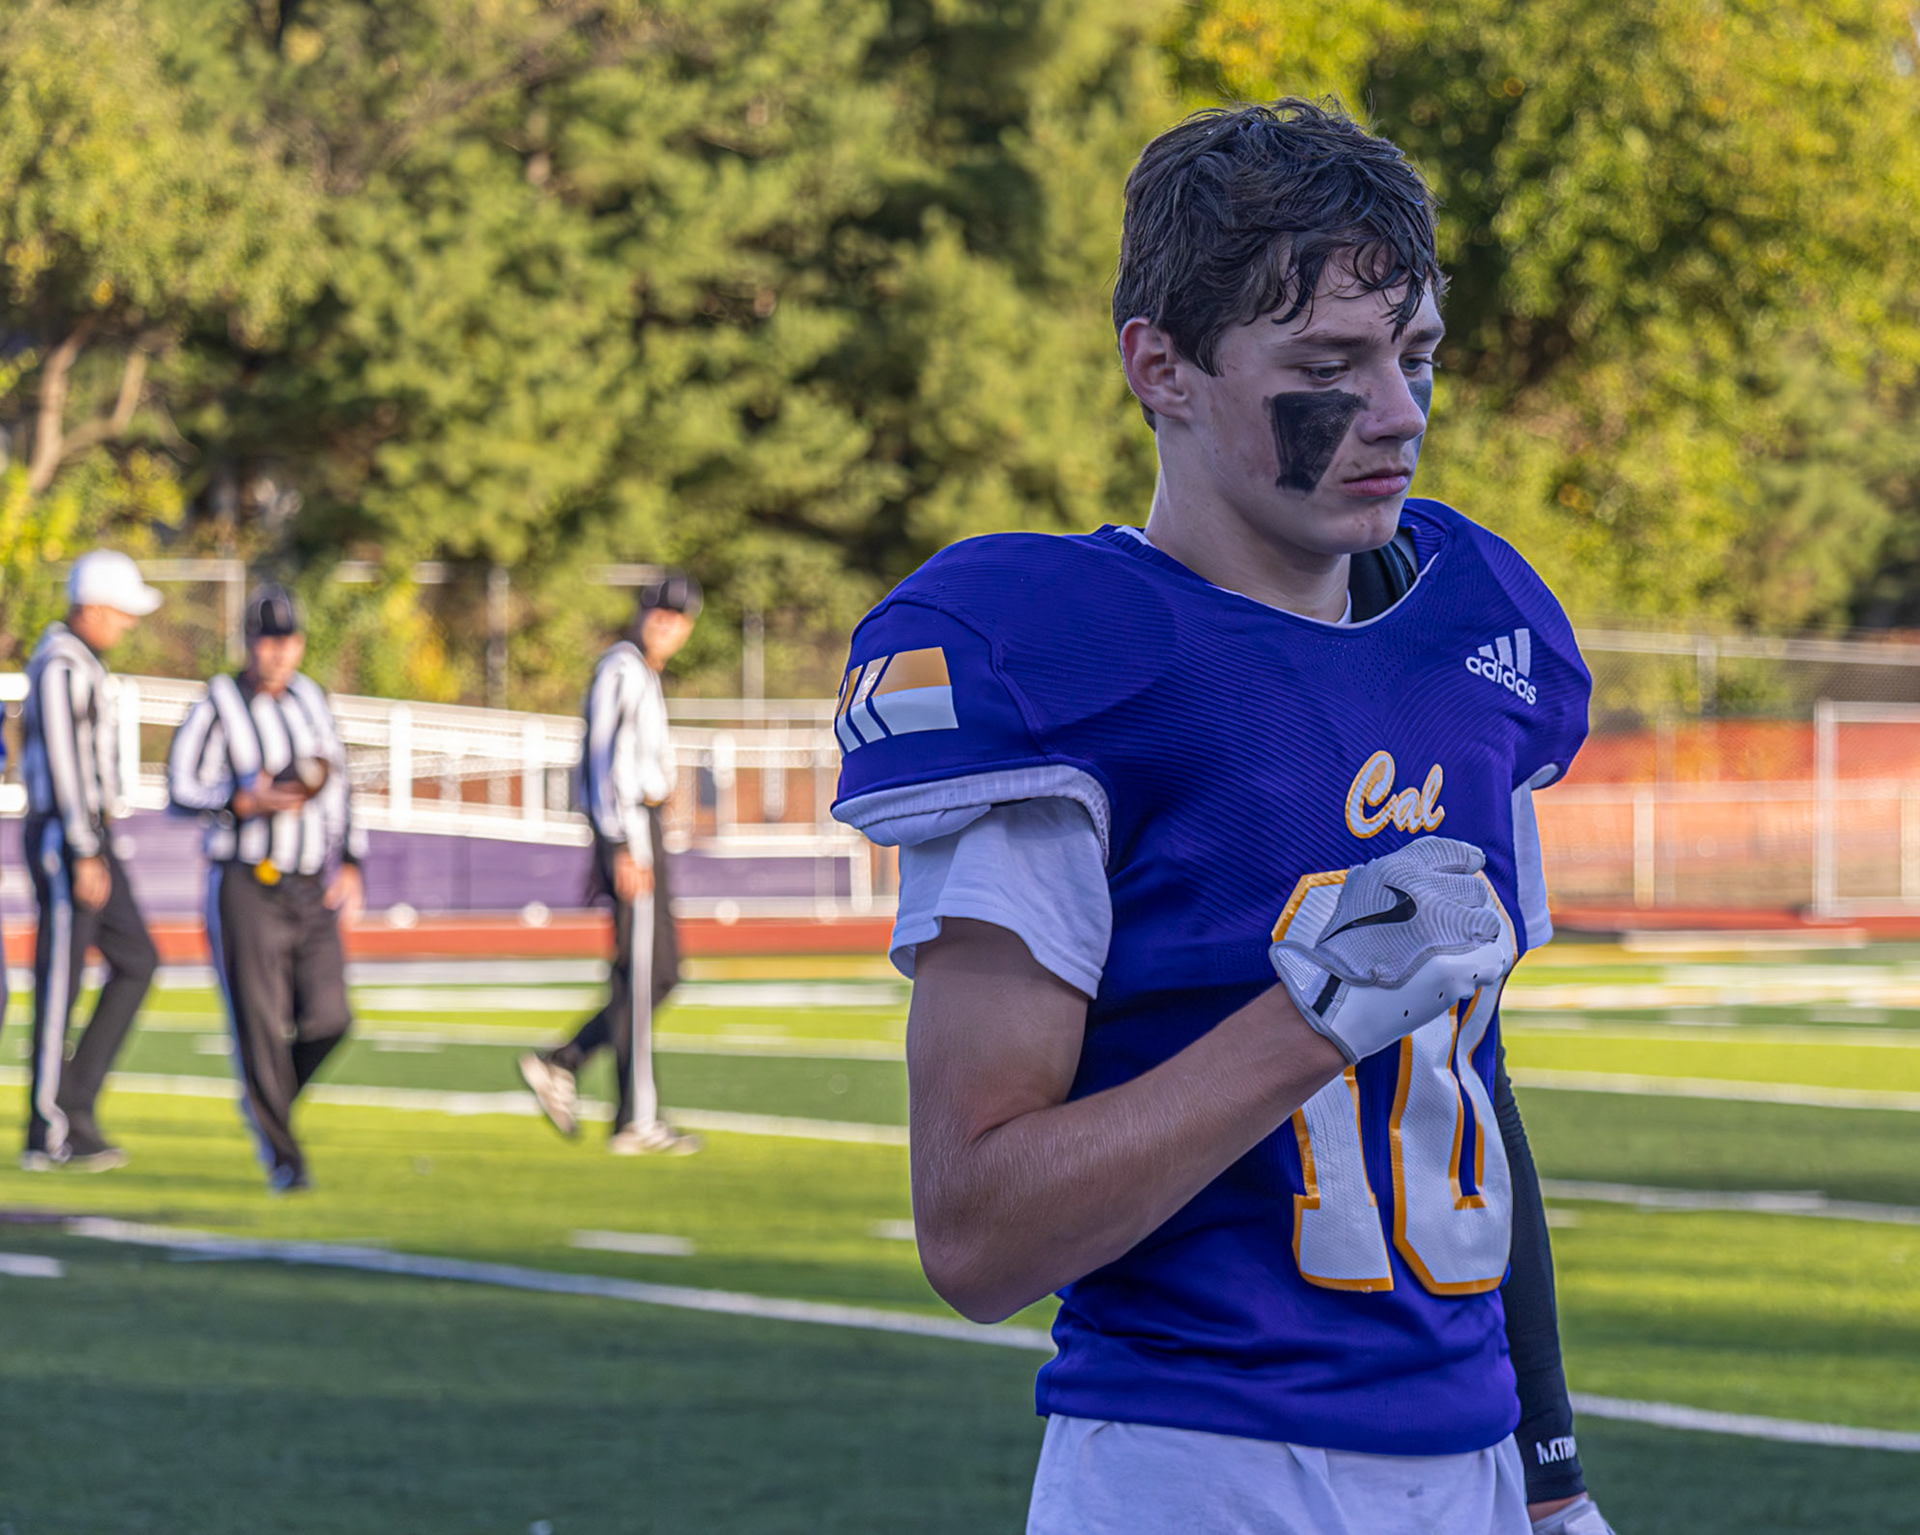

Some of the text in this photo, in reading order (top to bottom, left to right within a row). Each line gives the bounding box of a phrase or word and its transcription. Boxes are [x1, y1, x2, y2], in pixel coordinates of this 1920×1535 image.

[1465, 656, 1537, 706] adidas
[1345, 750, 1445, 839] Cal
[1271, 868, 1517, 1296] 10
